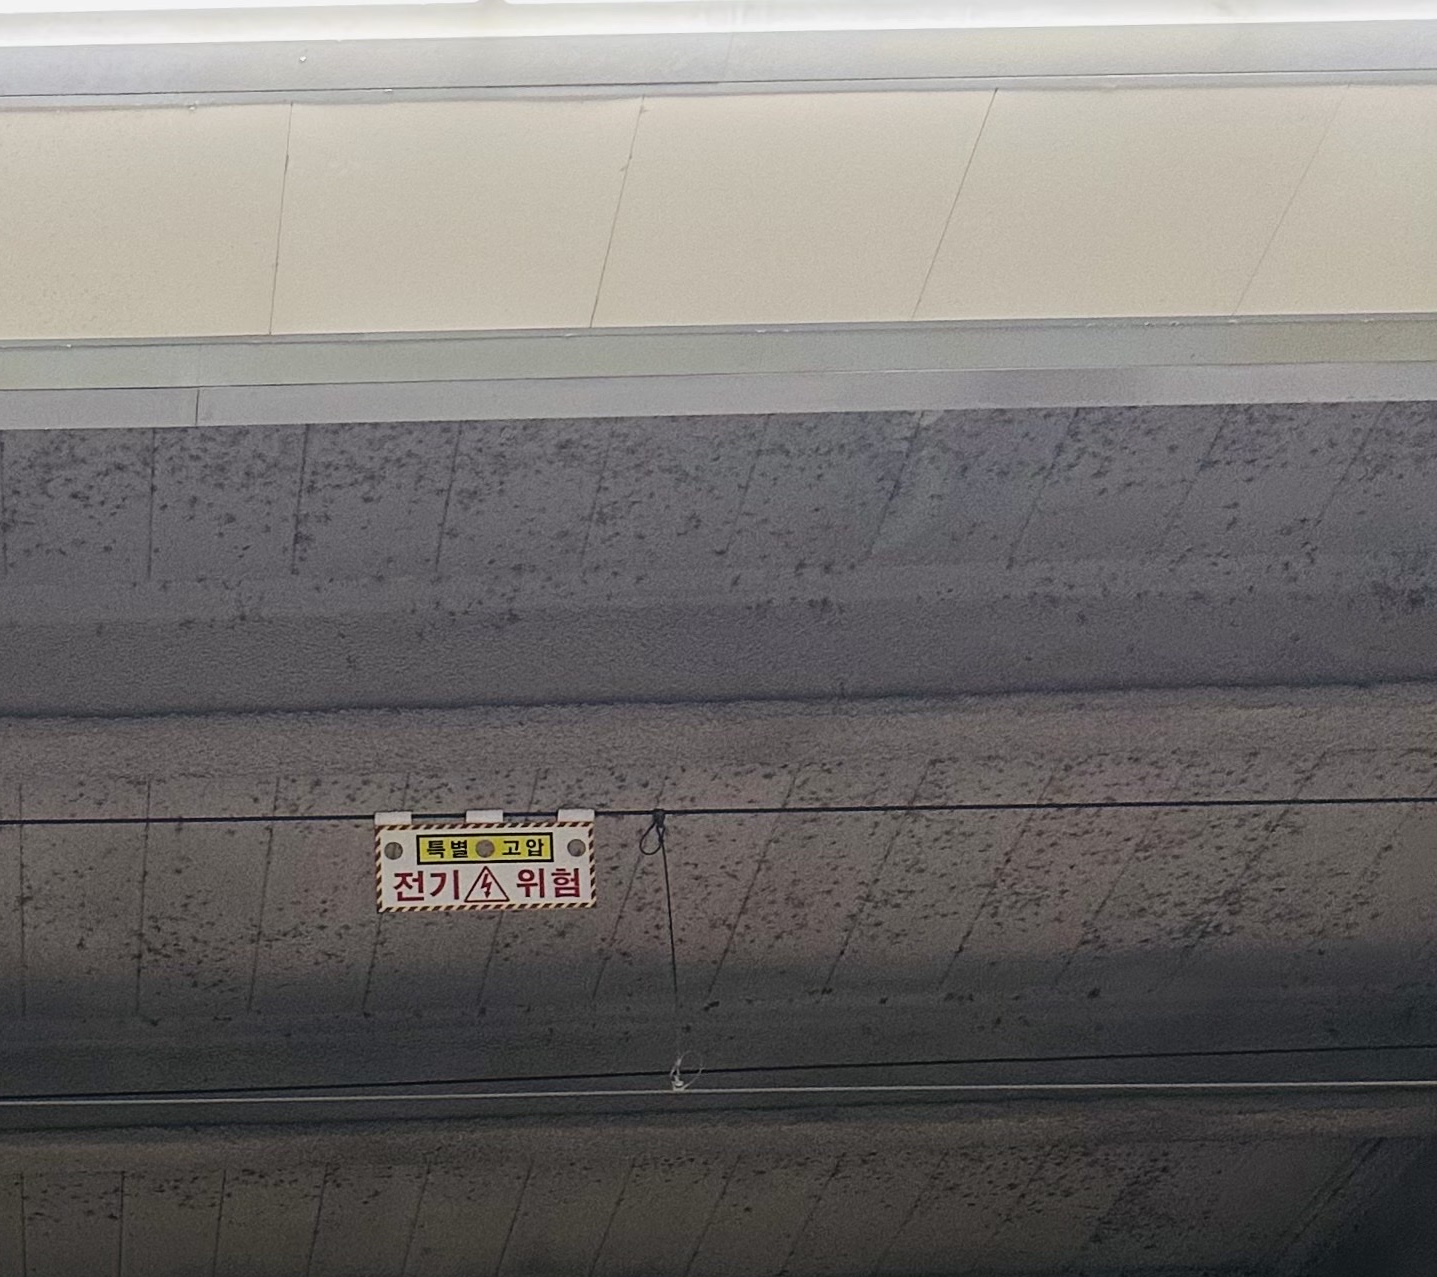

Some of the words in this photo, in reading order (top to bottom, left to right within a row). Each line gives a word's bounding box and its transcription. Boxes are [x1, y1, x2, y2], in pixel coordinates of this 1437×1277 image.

[426, 839, 469, 859] 특별
[502, 838, 545, 857] 고압
[392, 869, 460, 901] 전기
[516, 867, 581, 898] 위험
